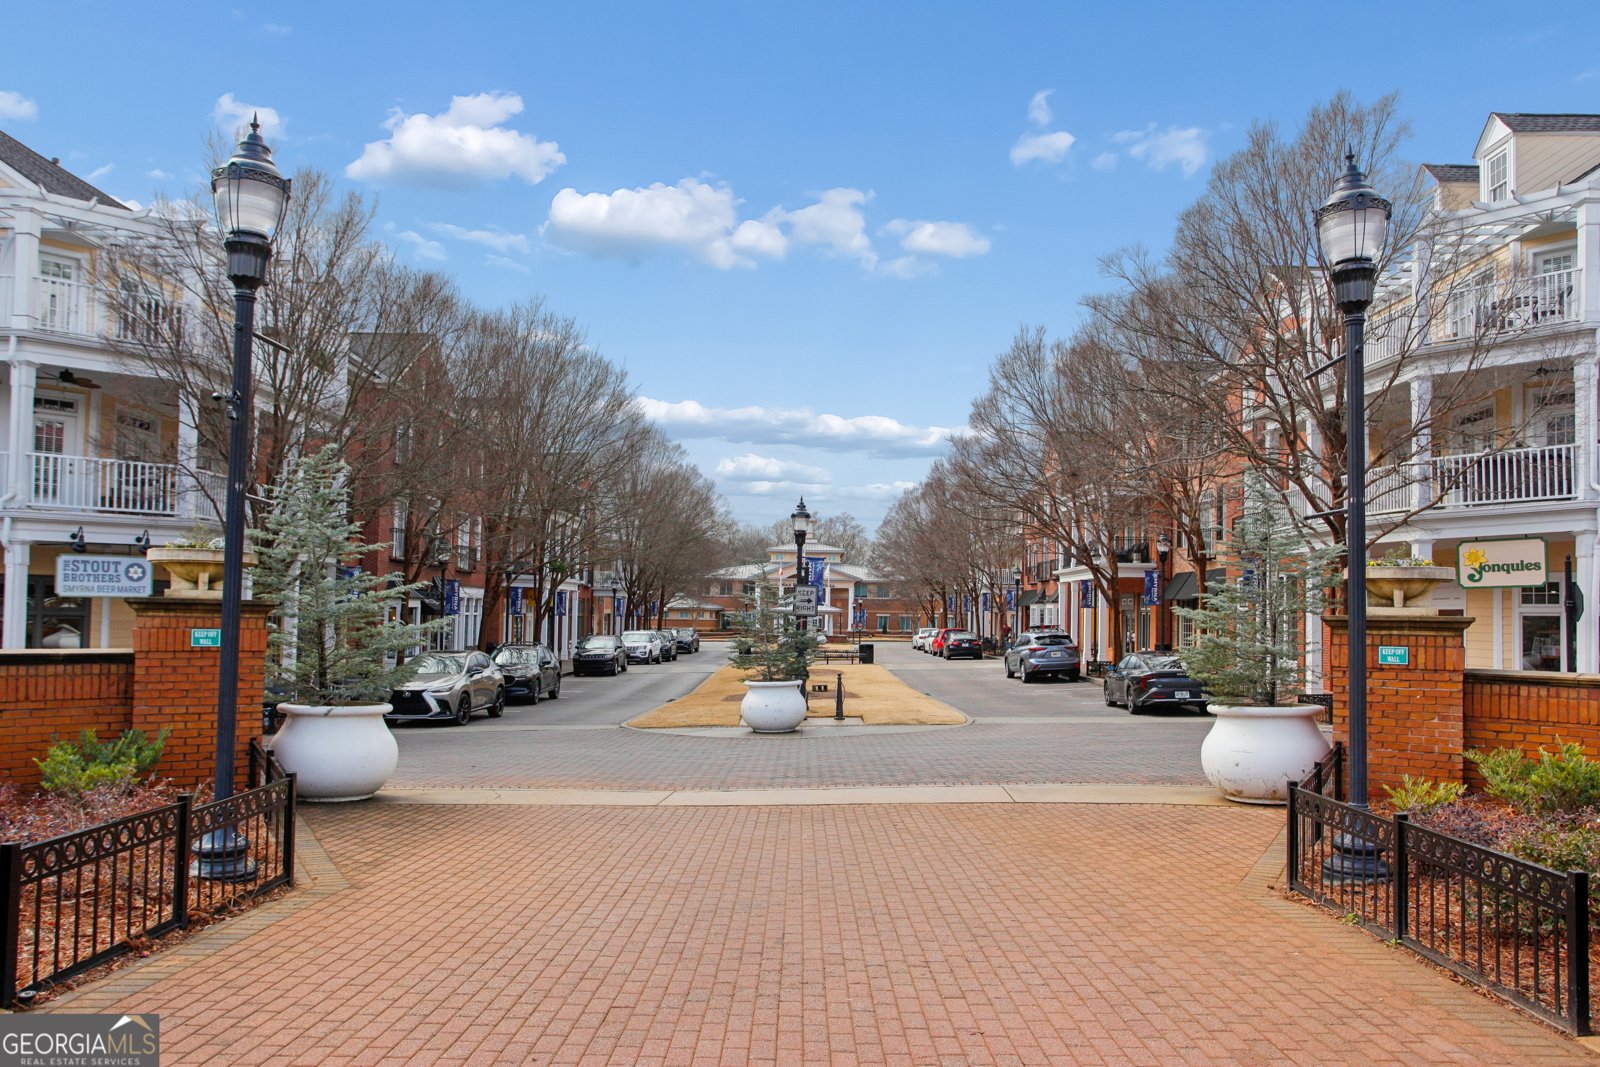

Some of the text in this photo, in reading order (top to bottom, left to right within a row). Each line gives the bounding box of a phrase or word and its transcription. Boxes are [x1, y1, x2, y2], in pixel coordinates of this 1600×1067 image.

[71, 560, 122, 573] STOUT
[63, 572, 122, 583] BROTHERS
[63, 584, 146, 594] SMYRNA BEER MARKET
